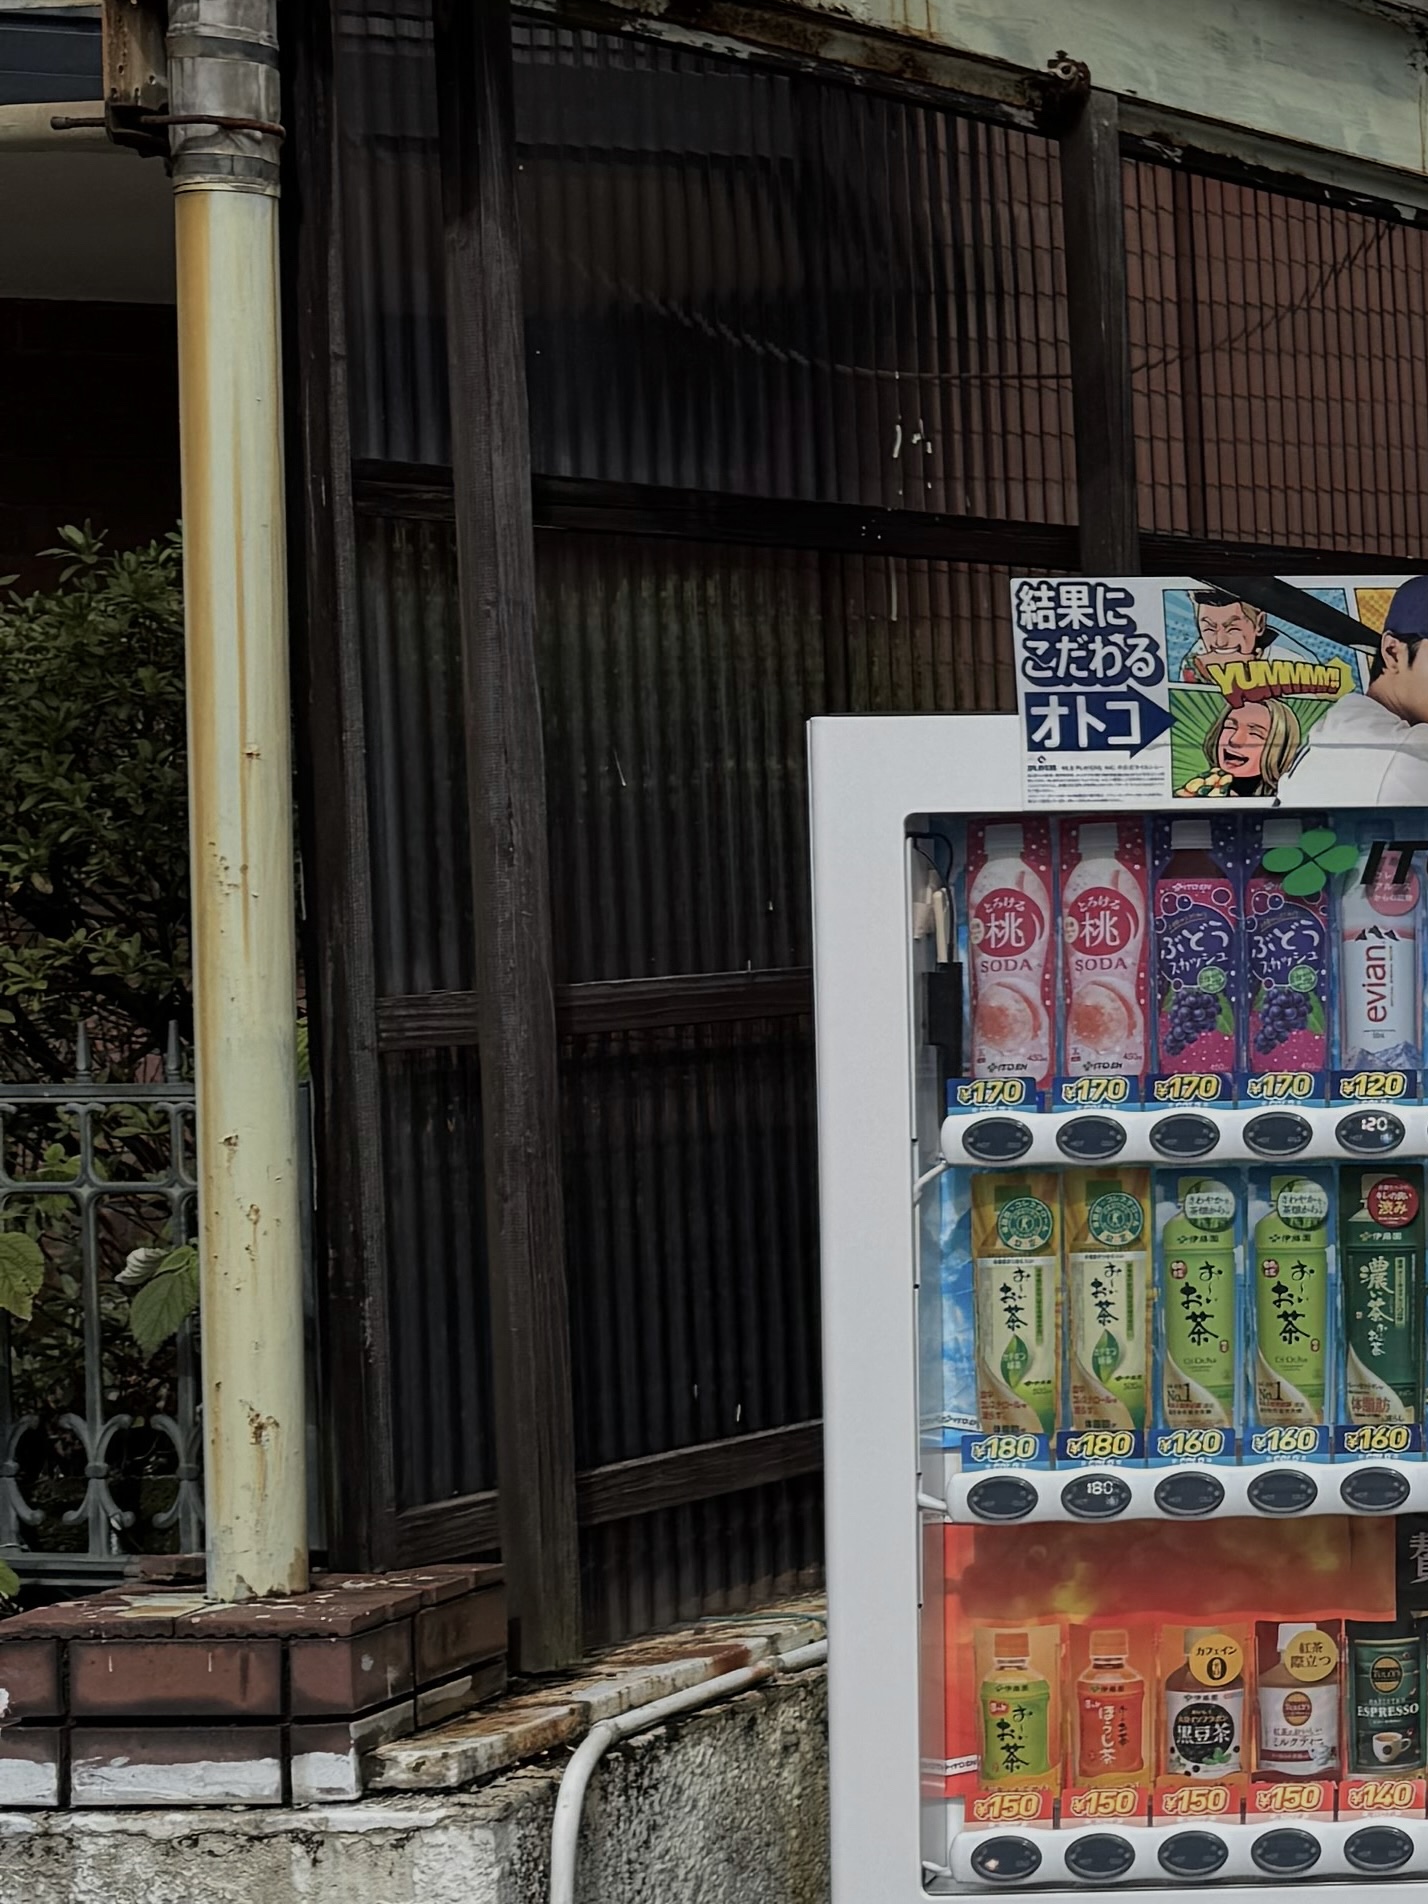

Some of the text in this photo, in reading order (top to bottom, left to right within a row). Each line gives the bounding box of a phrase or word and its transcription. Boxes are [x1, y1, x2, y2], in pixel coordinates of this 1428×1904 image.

[1018, 582, 1129, 631] 結果に
[1024, 634, 1157, 679] こだわる
[1030, 694, 1142, 748] オトコ
[984, 914, 1027, 949] 桃
[1079, 914, 1121, 949] 桃
[1160, 920, 1230, 959] ぶどう
[1251, 919, 1321, 958] ぶどう
[980, 957, 1033, 973] SODA
[1075, 956, 1129, 972] SODA
[1168, 952, 1229, 975] スカッシュ
[1260, 951, 1319, 974] スカッシュ
[1361, 943, 1388, 1023] evian
[957, 1077, 1026, 1107] ¥170
[1062, 1075, 1131, 1105] ¥170
[1154, 1073, 1224, 1102] ¥170
[1248, 1072, 1316, 1100] ¥170
[1340, 1070, 1405, 1098] ¥120
[970, 1434, 1040, 1463] ¥180
[1067, 1431, 1135, 1461] ¥180
[1157, 1429, 1225, 1457] ¥160
[1252, 1426, 1319, 1455] ¥160
[1344, 1424, 1412, 1452] ¥160
[1290, 1654, 1332, 1669] 際立つ
[1299, 1641, 1323, 1654] 紅茶
[1357, 1703, 1420, 1718] ESPRESSO
[1175, 1724, 1231, 1745] 黒豆茶
[973, 1792, 1043, 1821] ¥150
[1069, 1788, 1137, 1816] ¥150
[1162, 1786, 1231, 1815] ¥150
[1255, 1783, 1323, 1812] ¥150
[1347, 1781, 1414, 1810] ¥140
